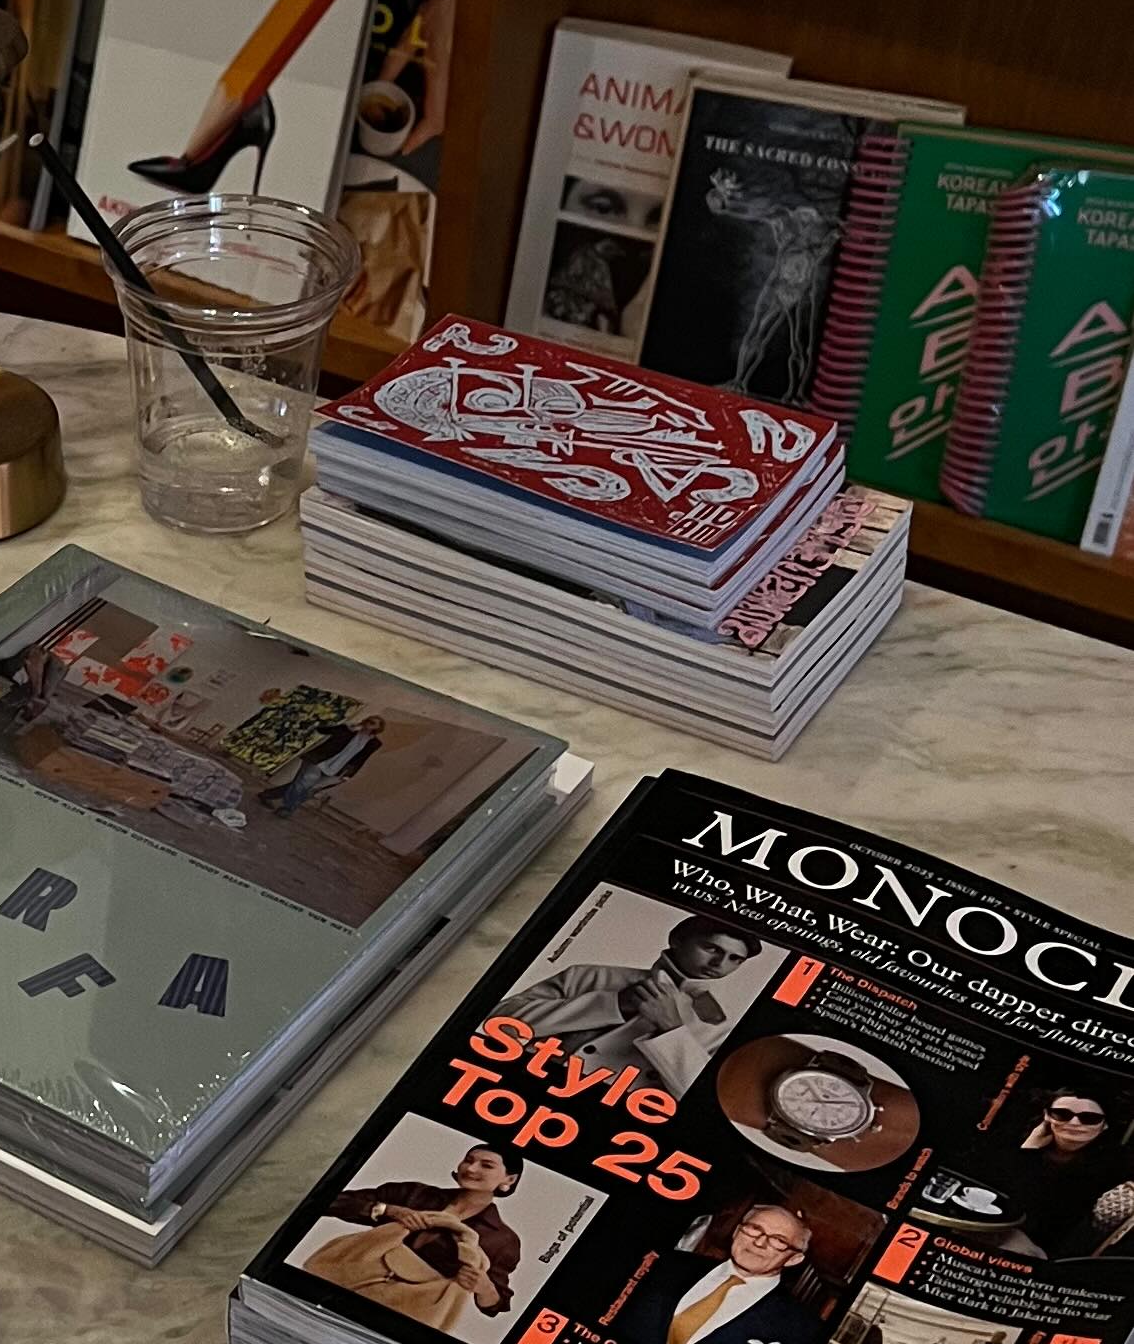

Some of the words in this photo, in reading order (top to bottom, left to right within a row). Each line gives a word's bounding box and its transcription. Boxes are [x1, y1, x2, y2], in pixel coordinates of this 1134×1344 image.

[704, 134, 740, 154] THE
[742, 142, 814, 169] SACRED
[672, 859, 735, 897] Who,
[746, 884, 818, 928] What,
[829, 914, 901, 957] Wear:
[907, 948, 963, 987] Our
[968, 975, 1066, 1032] dapper
[1013, 906, 1052, 933] STYLE
[1052, 924, 1103, 953] SPECIAL
[672, 879, 721, 907] PLUS:
[725, 899, 765, 923] New
[765, 914, 846, 955] openings,
[850, 944, 878, 969] old
[876, 955, 969, 1006] favourites
[970, 996, 1008, 1022] and
[1006, 1013, 1093, 1056] far-flung
[801, 959, 814, 977] 1
[829, 966, 855, 984] The
[857, 977, 918, 1011] Dispatch
[814, 1005, 857, 1032] Spain's
[820, 996, 884, 1031] Leadership
[826, 988, 848, 1006] Can
[849, 999, 874, 1020] you
[832, 980, 910, 1023] Billion-dollar
[947, 1031, 987, 1054] games
[468, 1015, 678, 1125] Style
[441, 1058, 580, 1149] Top
[591, 1130, 713, 1201] 25
[537, 1237, 559, 1264] Bags
[896, 1227, 922, 1249] 2
[932, 1236, 985, 1261] Global
[987, 1255, 1034, 1274] views
[926, 1272, 985, 1298] Taiwan's
[987, 1291, 1041, 1310] reliable
[1042, 1303, 1082, 1318] radio
[1083, 1310, 1113, 1322] star
[931, 1263, 1029, 1297] Underground
[1030, 1288, 1061, 1304] bike
[1061, 1295, 1100, 1310] lanes
[935, 1253, 997, 1279] Muscat's
[999, 1273, 1054, 1292] modern
[1056, 1284, 1127, 1303] makeover
[536, 1313, 561, 1335] 3
[917, 1283, 956, 1302] After
[957, 1295, 990, 1312] dark
[991, 1304, 1008, 1316] in
[1007, 1308, 1062, 1326] Jakarta
[572, 1322, 601, 1344] The
